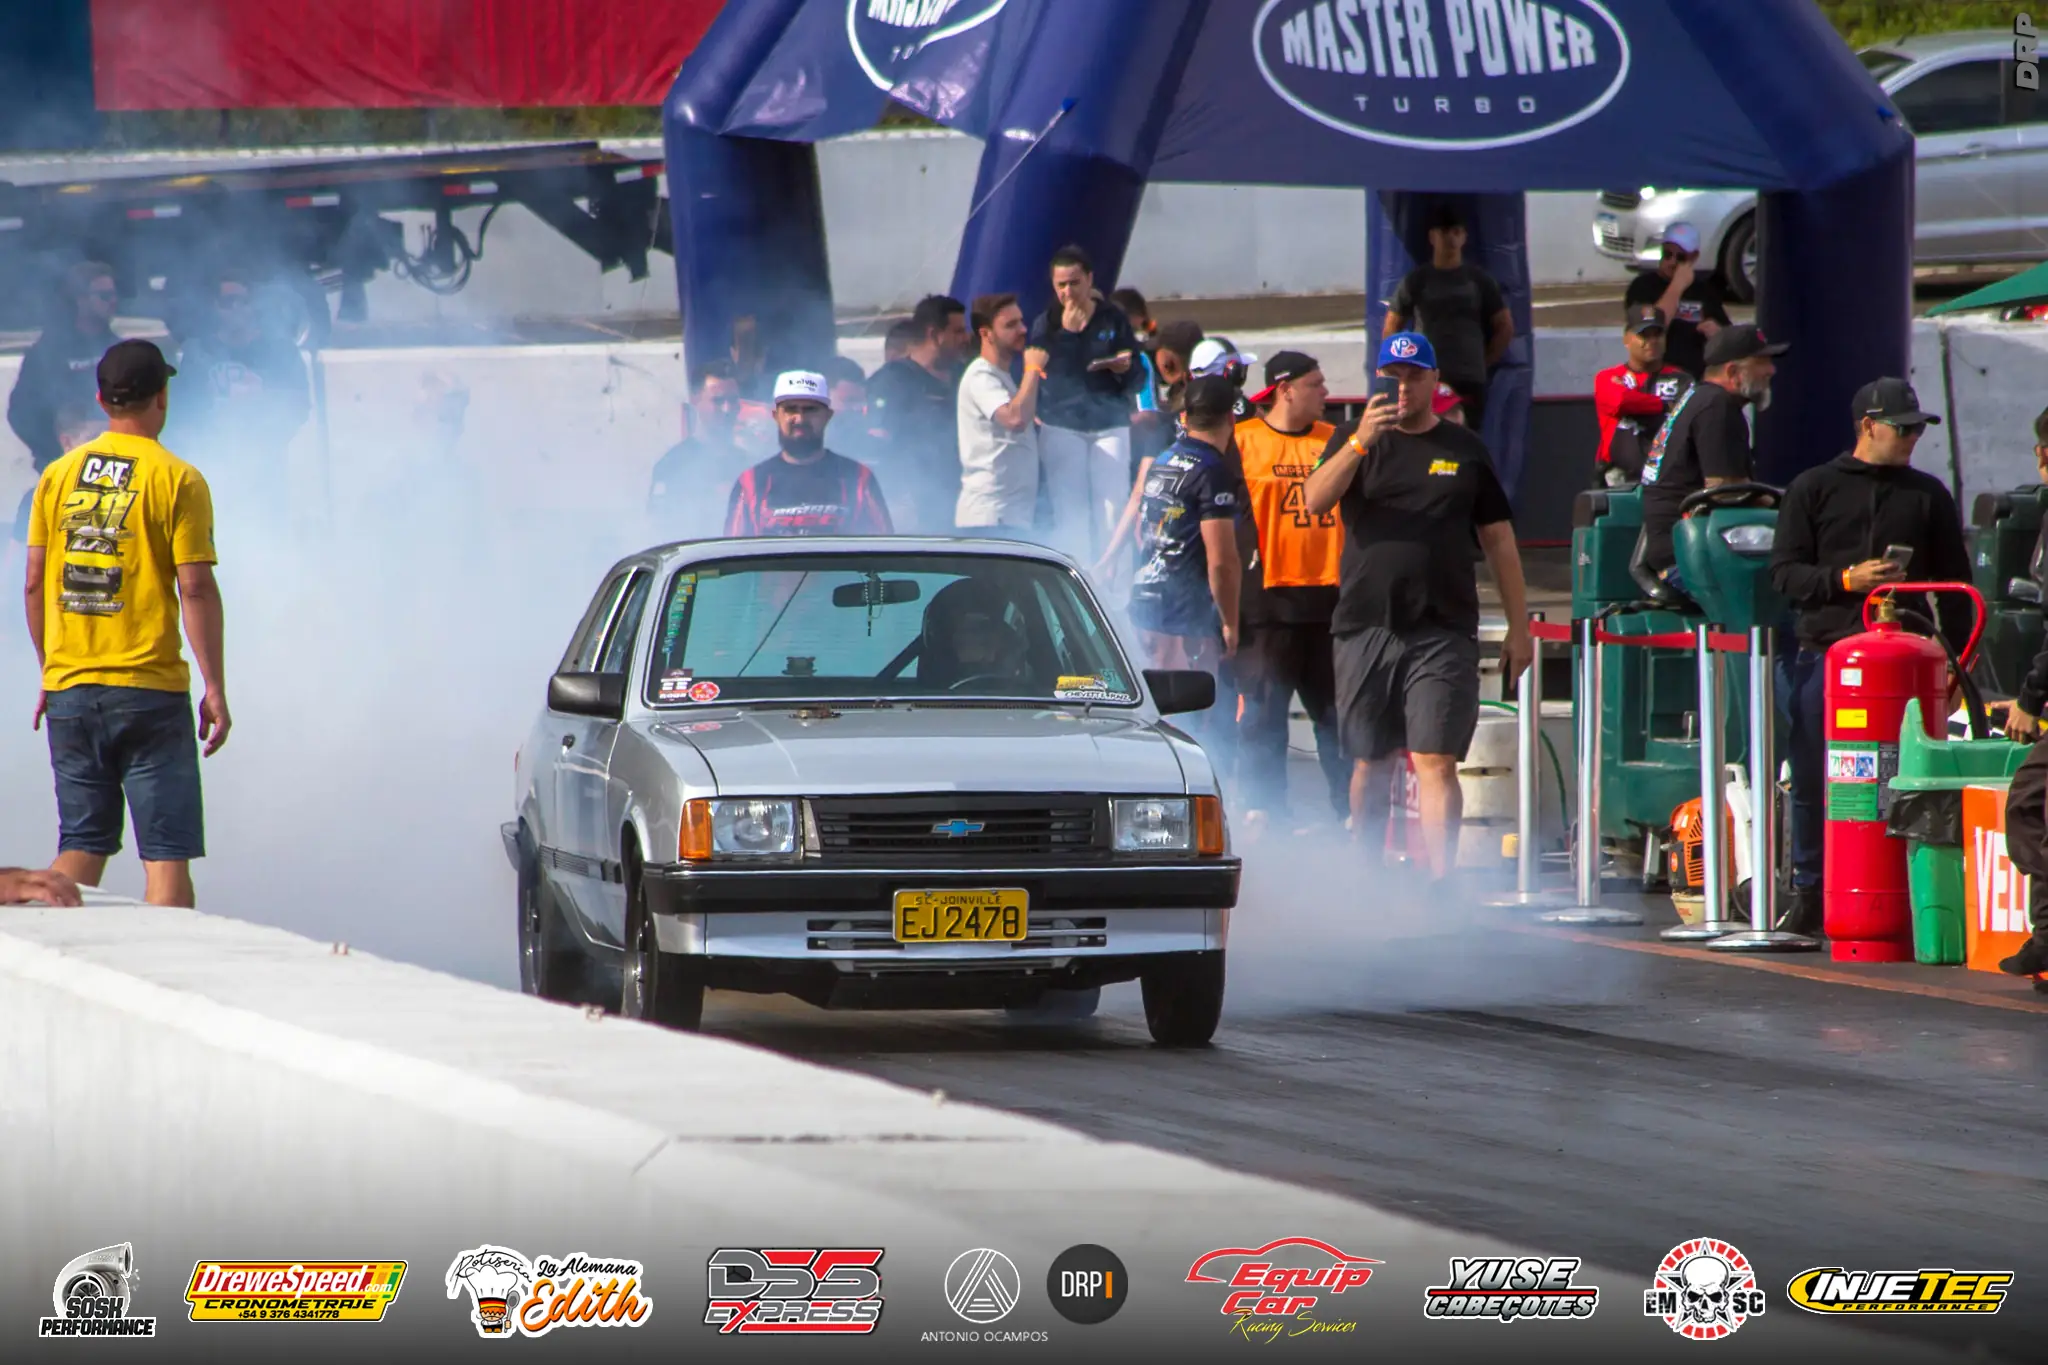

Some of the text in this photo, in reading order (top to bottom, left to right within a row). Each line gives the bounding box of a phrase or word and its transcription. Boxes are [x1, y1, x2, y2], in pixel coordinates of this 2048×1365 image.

[1281, 0, 1597, 78] MASTER POWER
[1354, 97, 1536, 113] TURBO
[82, 457, 130, 488] CAT
